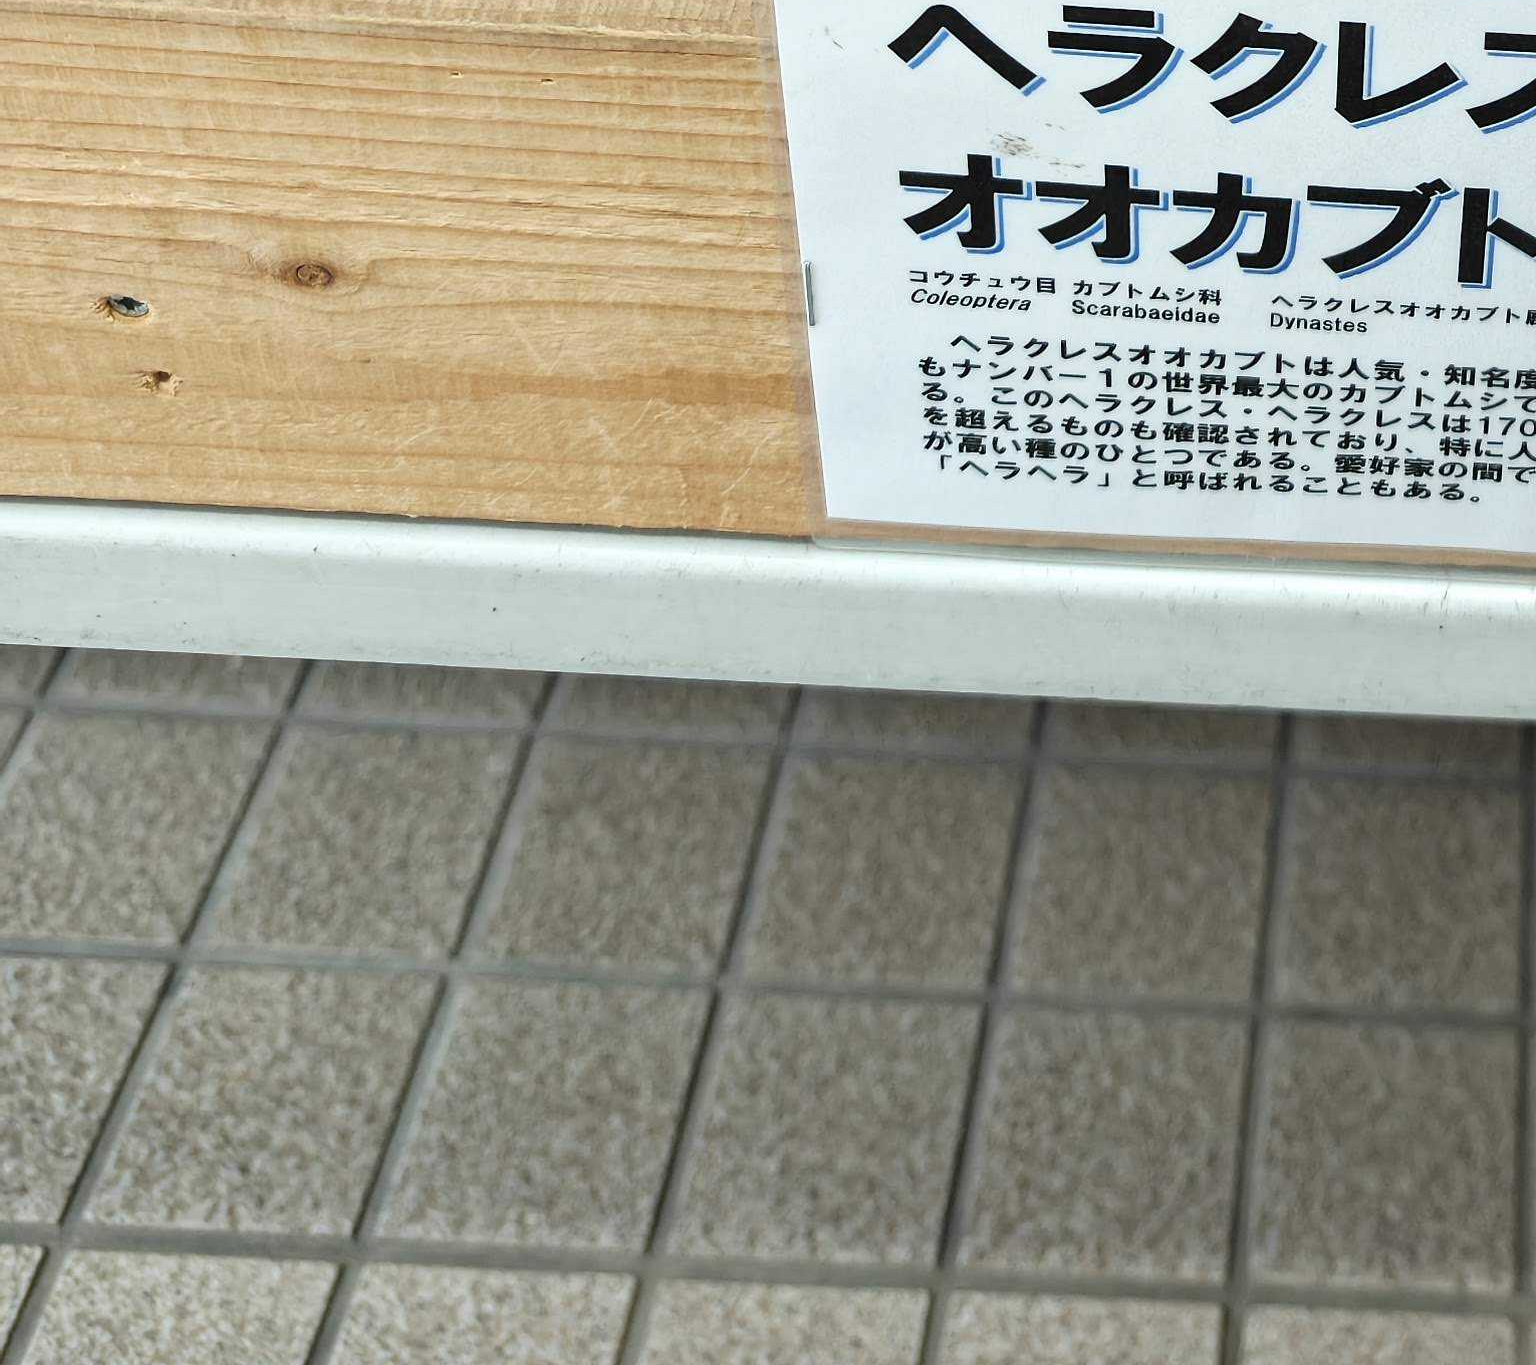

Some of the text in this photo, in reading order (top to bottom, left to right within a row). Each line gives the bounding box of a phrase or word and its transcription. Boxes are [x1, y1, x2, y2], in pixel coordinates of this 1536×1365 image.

[909, 270, 1056, 294] コウチュウ目
[1072, 279, 1222, 306] カブトムシ科
[910, 288, 1367, 333] Coleoptera Scarabaeidae Dynastes
[939, 454, 1480, 504] 「ヘラヘラ」と呼ばれることもある。
